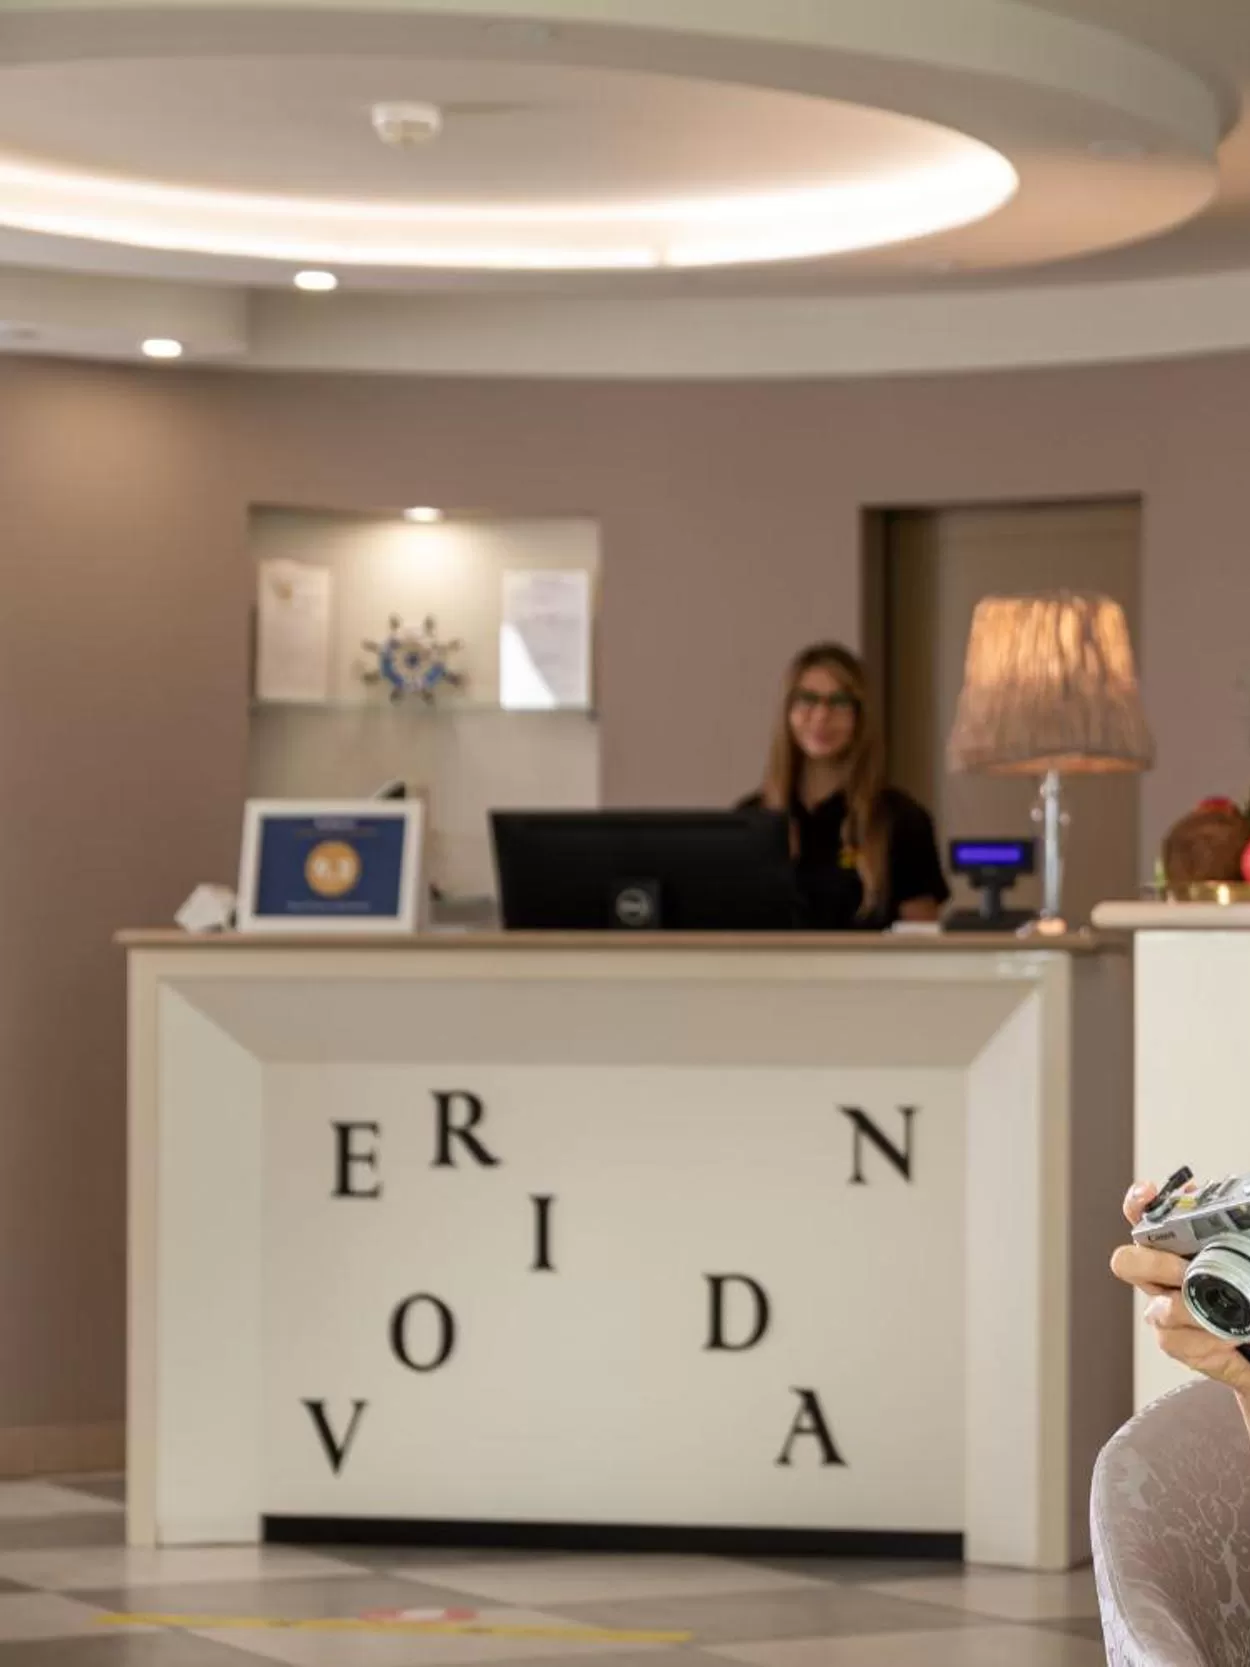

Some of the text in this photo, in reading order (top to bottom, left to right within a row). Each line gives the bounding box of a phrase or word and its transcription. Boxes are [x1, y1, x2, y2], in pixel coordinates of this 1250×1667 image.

[332, 1121, 380, 1199] E
[432, 1090, 500, 1168] R
[840, 1106, 916, 1184] N
[530, 1194, 555, 1272] I
[389, 1293, 456, 1373] O
[705, 1274, 771, 1352] D
[302, 1399, 366, 1475] V
[776, 1388, 848, 1467] A
